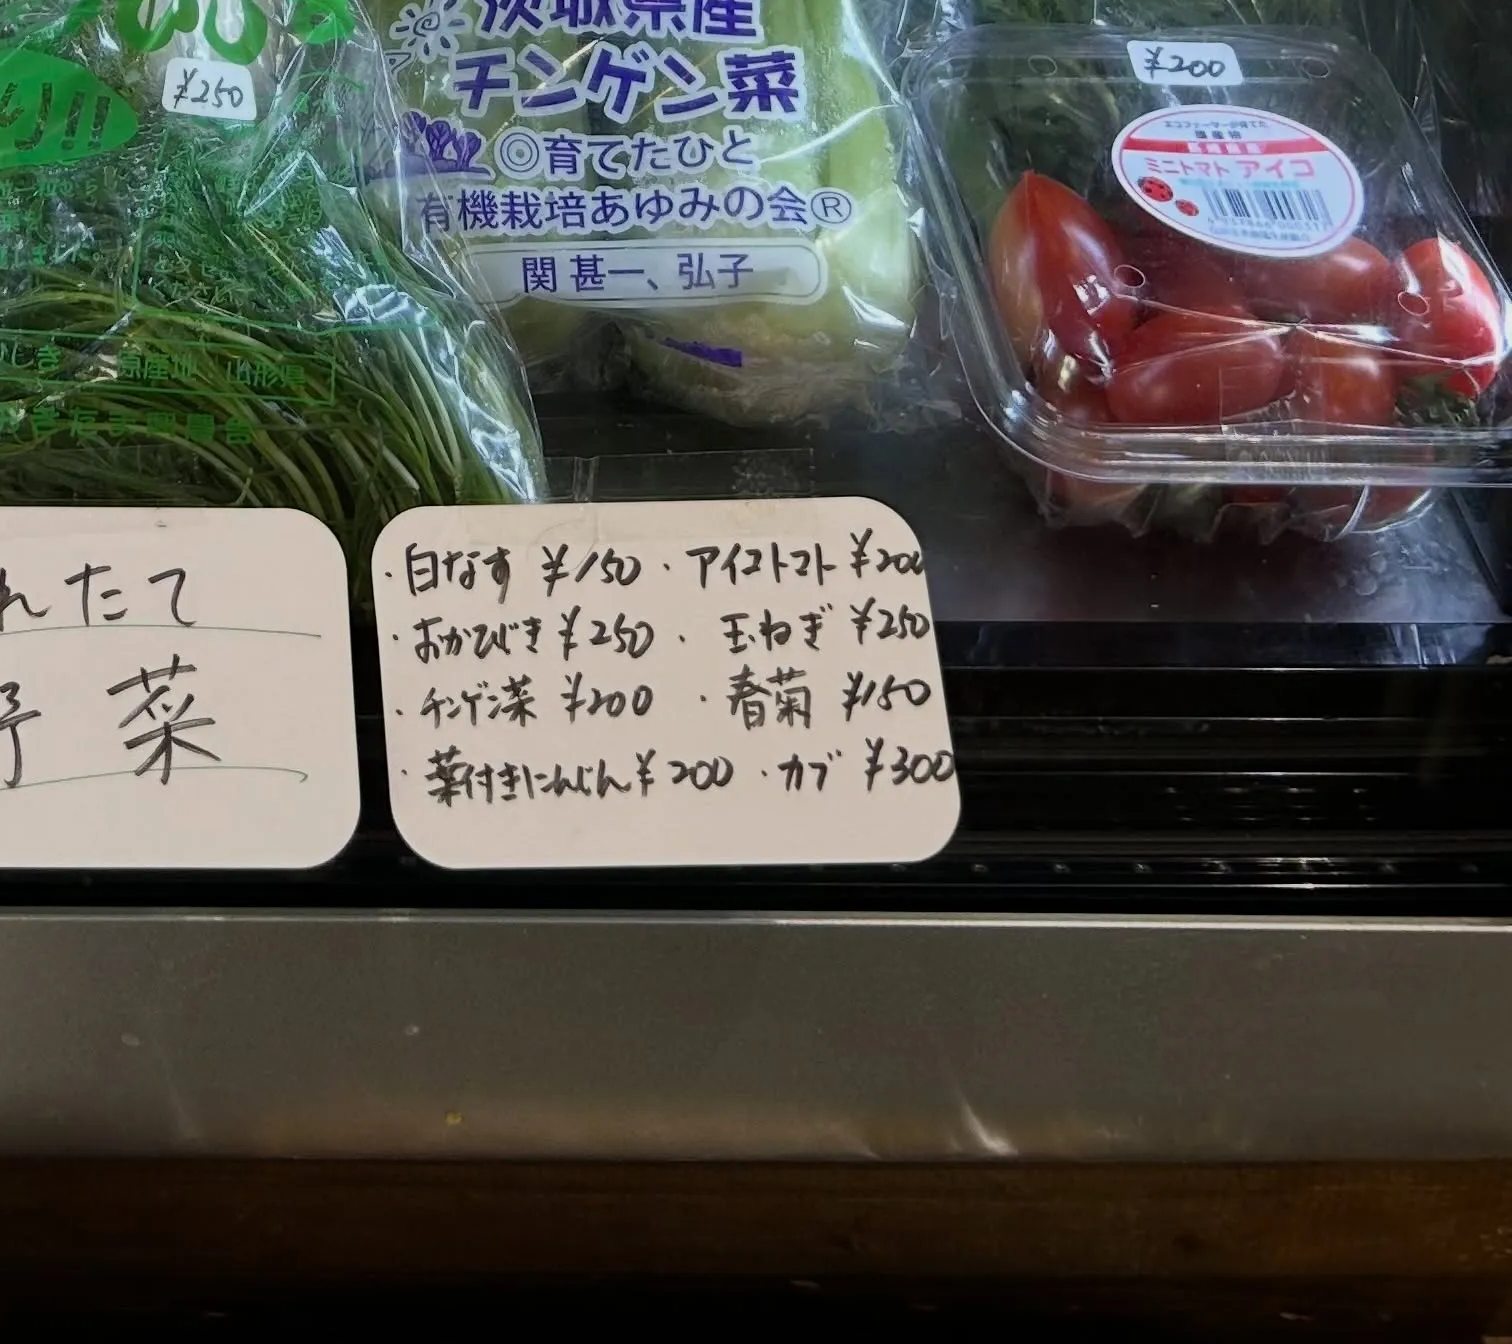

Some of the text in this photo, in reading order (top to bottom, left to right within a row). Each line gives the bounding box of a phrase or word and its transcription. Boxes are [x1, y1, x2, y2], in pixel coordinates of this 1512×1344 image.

[174, 70, 245, 109] ¥250
[454, 48, 800, 116] チンゲン菜
[1144, 47, 1226, 80] ¥200
[1144, 158, 1316, 180] ミニトマト アイコ
[405, 542, 512, 605] 白なす
[541, 543, 642, 597] ¥150
[559, 605, 655, 660] ¥250
[720, 603, 834, 654] 玉ねぎ
[849, 597, 931, 645] ¥250
[564, 671, 653, 722] ¥200
[726, 664, 813, 730] 春菊
[843, 671, 932, 722] ¥150
[636, 749, 734, 798] ¥200
[777, 748, 843, 792] カブ
[864, 737, 954, 791] ¥300
